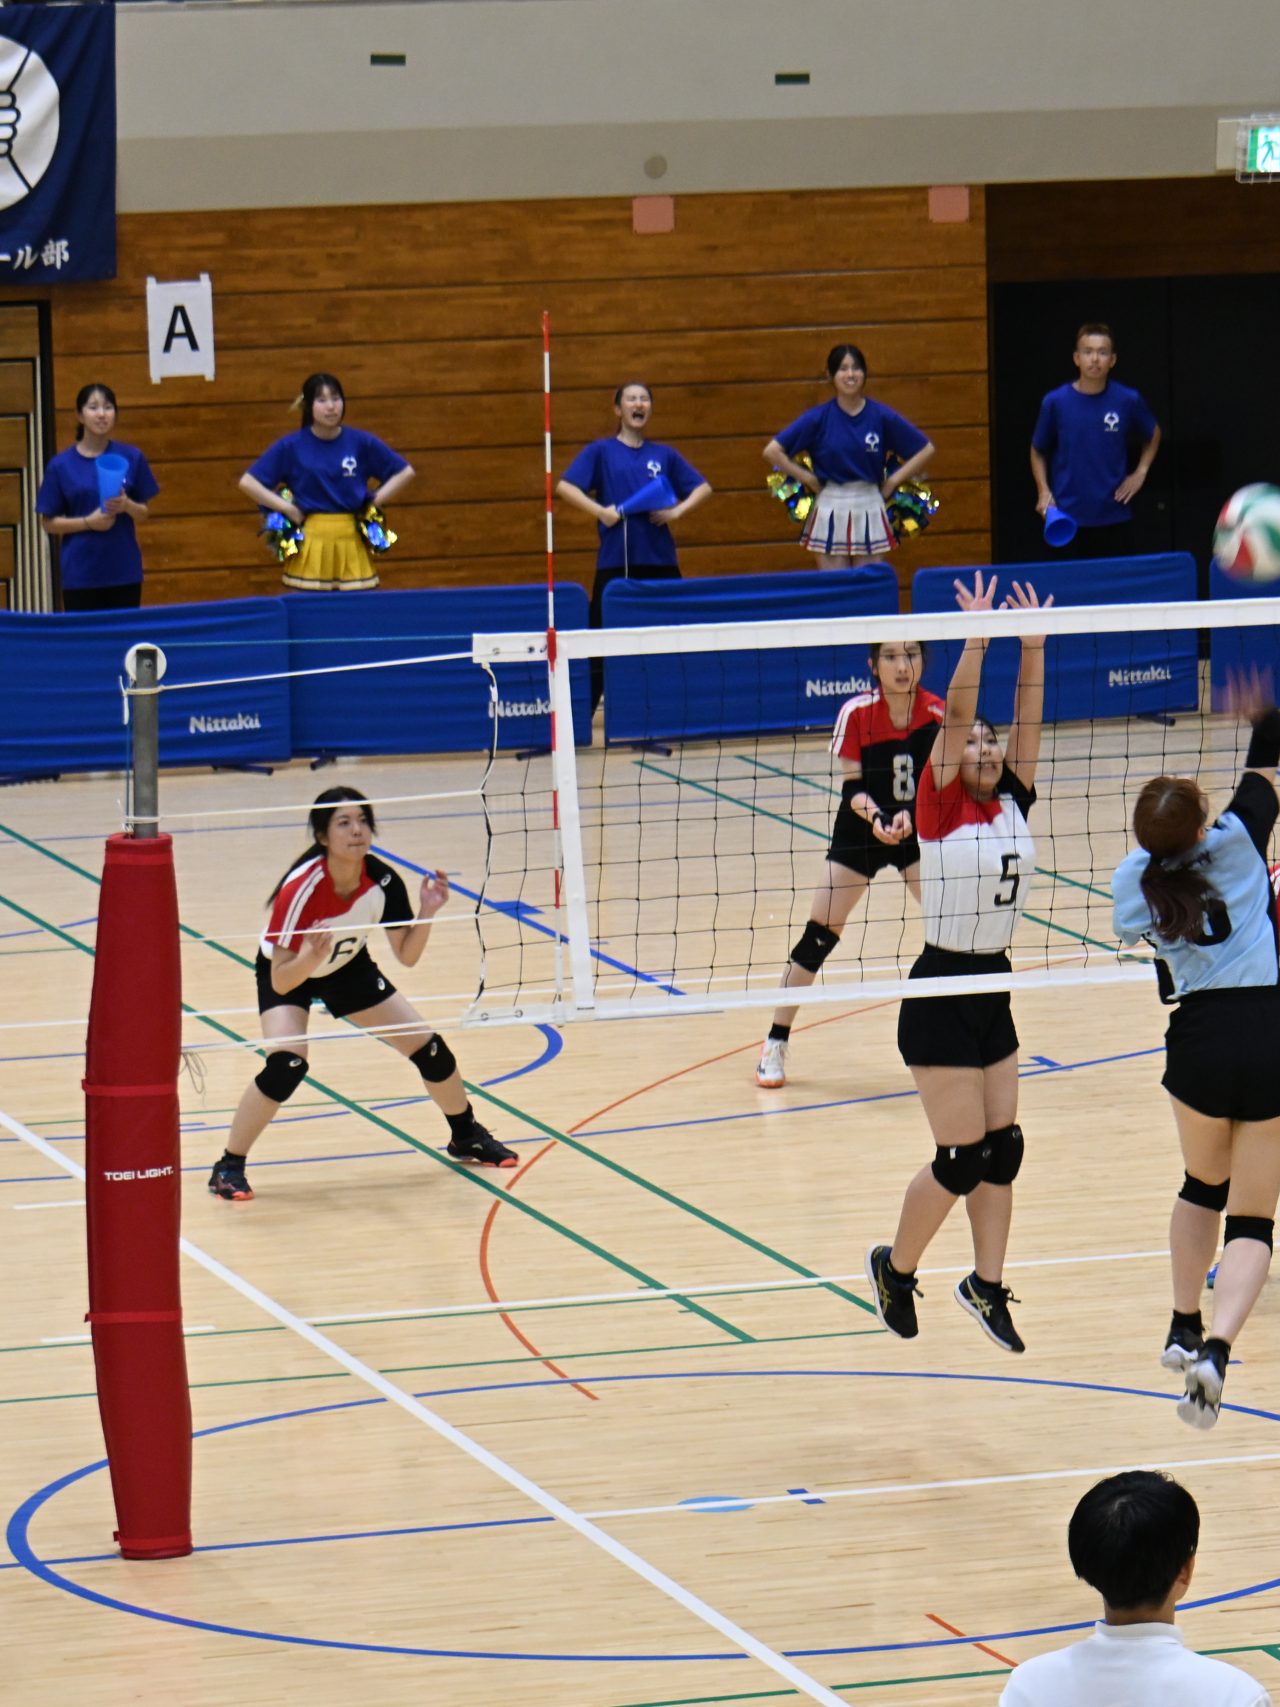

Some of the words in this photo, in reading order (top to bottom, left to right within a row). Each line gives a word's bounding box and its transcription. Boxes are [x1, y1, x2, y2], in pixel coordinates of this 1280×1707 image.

[162, 304, 200, 354] A
[806, 676, 872, 698] Nittaku
[1109, 664, 1172, 688] Nittaku
[189, 713, 262, 734] Nittaku
[892, 753, 917, 802] 8
[994, 853, 1022, 907] 5
[104, 1170, 135, 1181] TOEI
